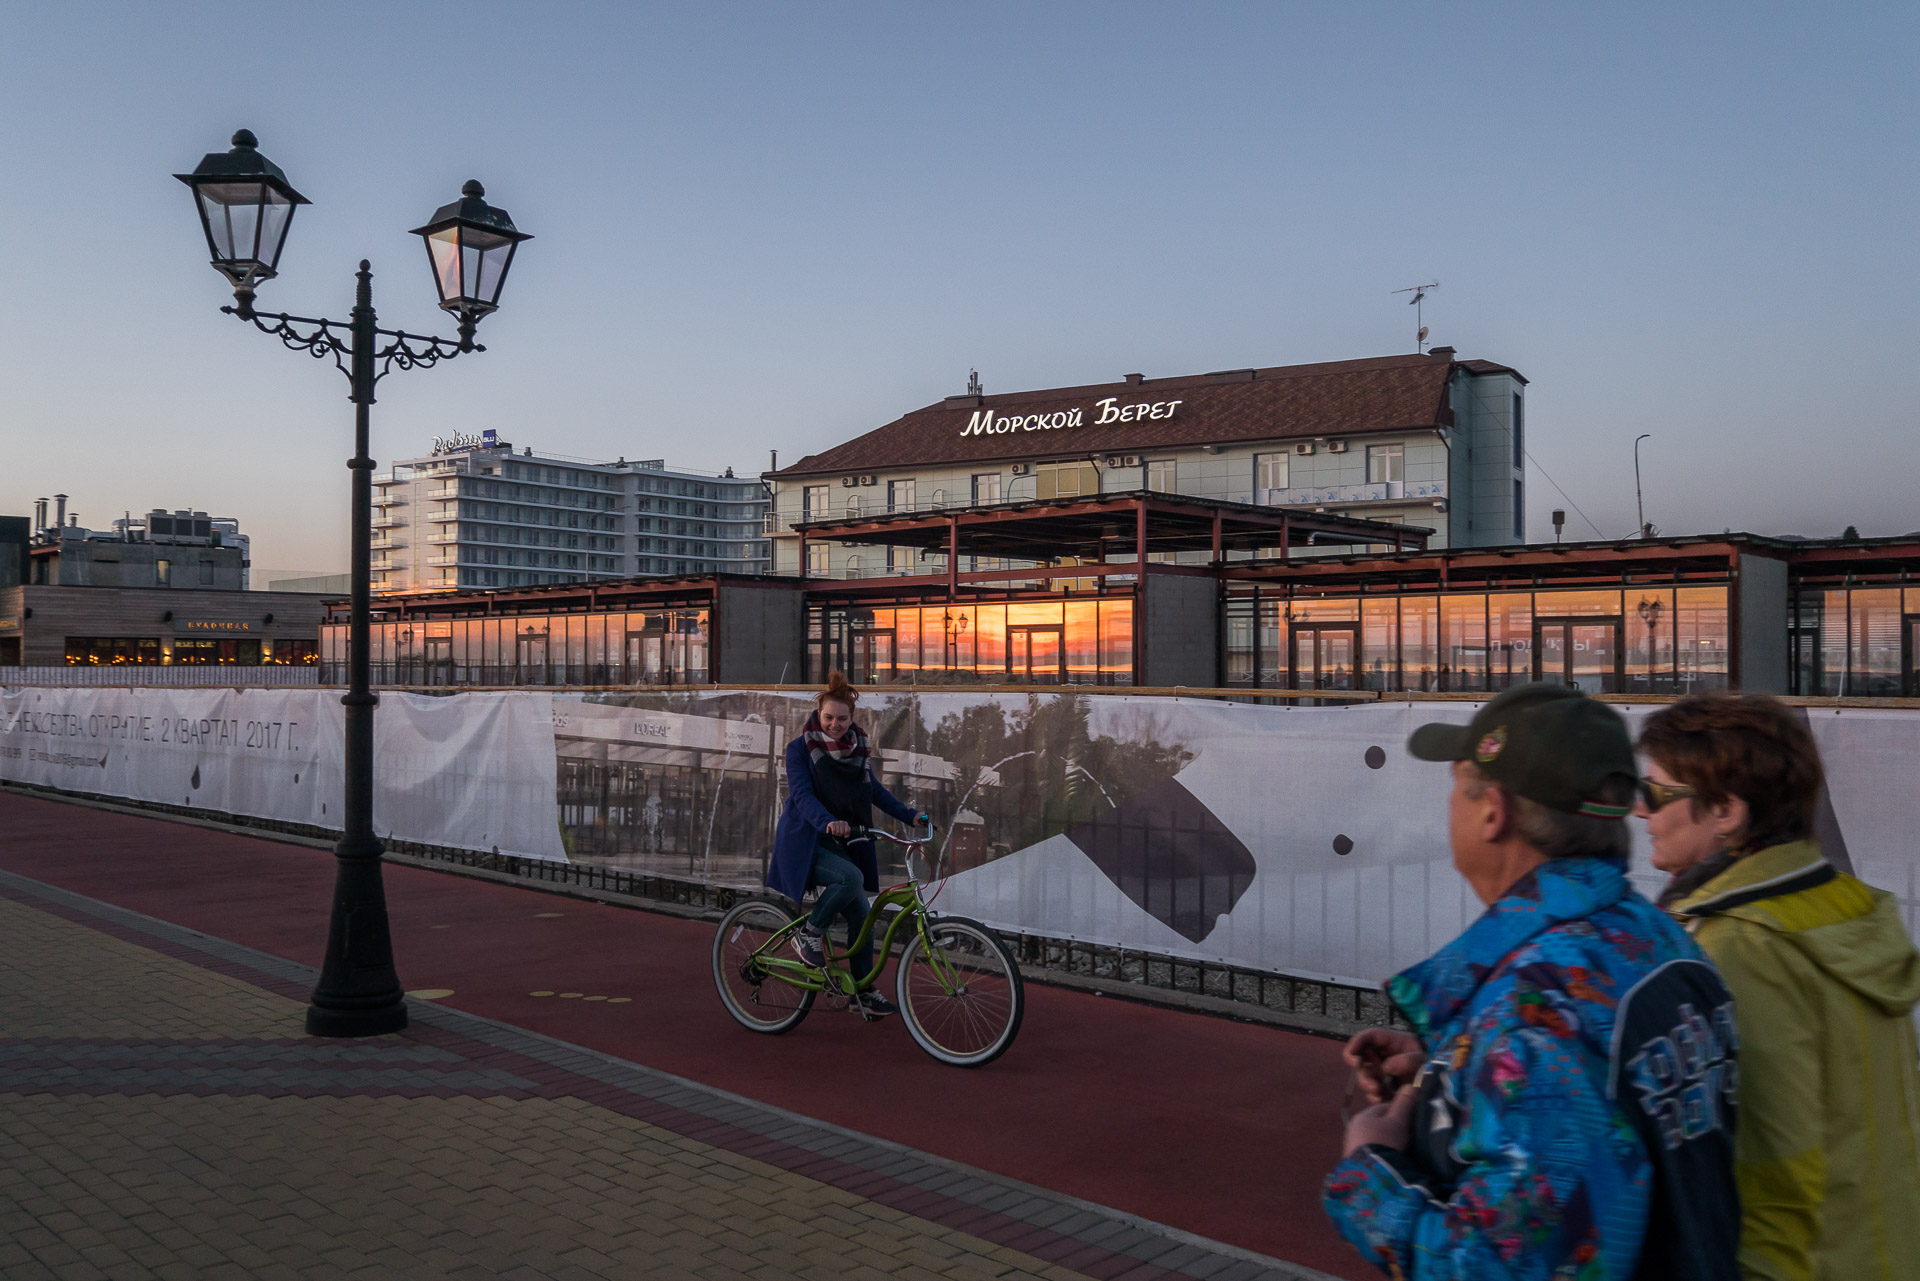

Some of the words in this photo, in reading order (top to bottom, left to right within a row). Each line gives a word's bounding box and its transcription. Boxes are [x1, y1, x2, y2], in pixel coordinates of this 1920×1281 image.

[161, 717, 170, 743] 2
[174, 718, 238, 747] КВАРТАЛ
[246, 720, 282, 750] 2017
[287, 722, 299, 751] Г.
